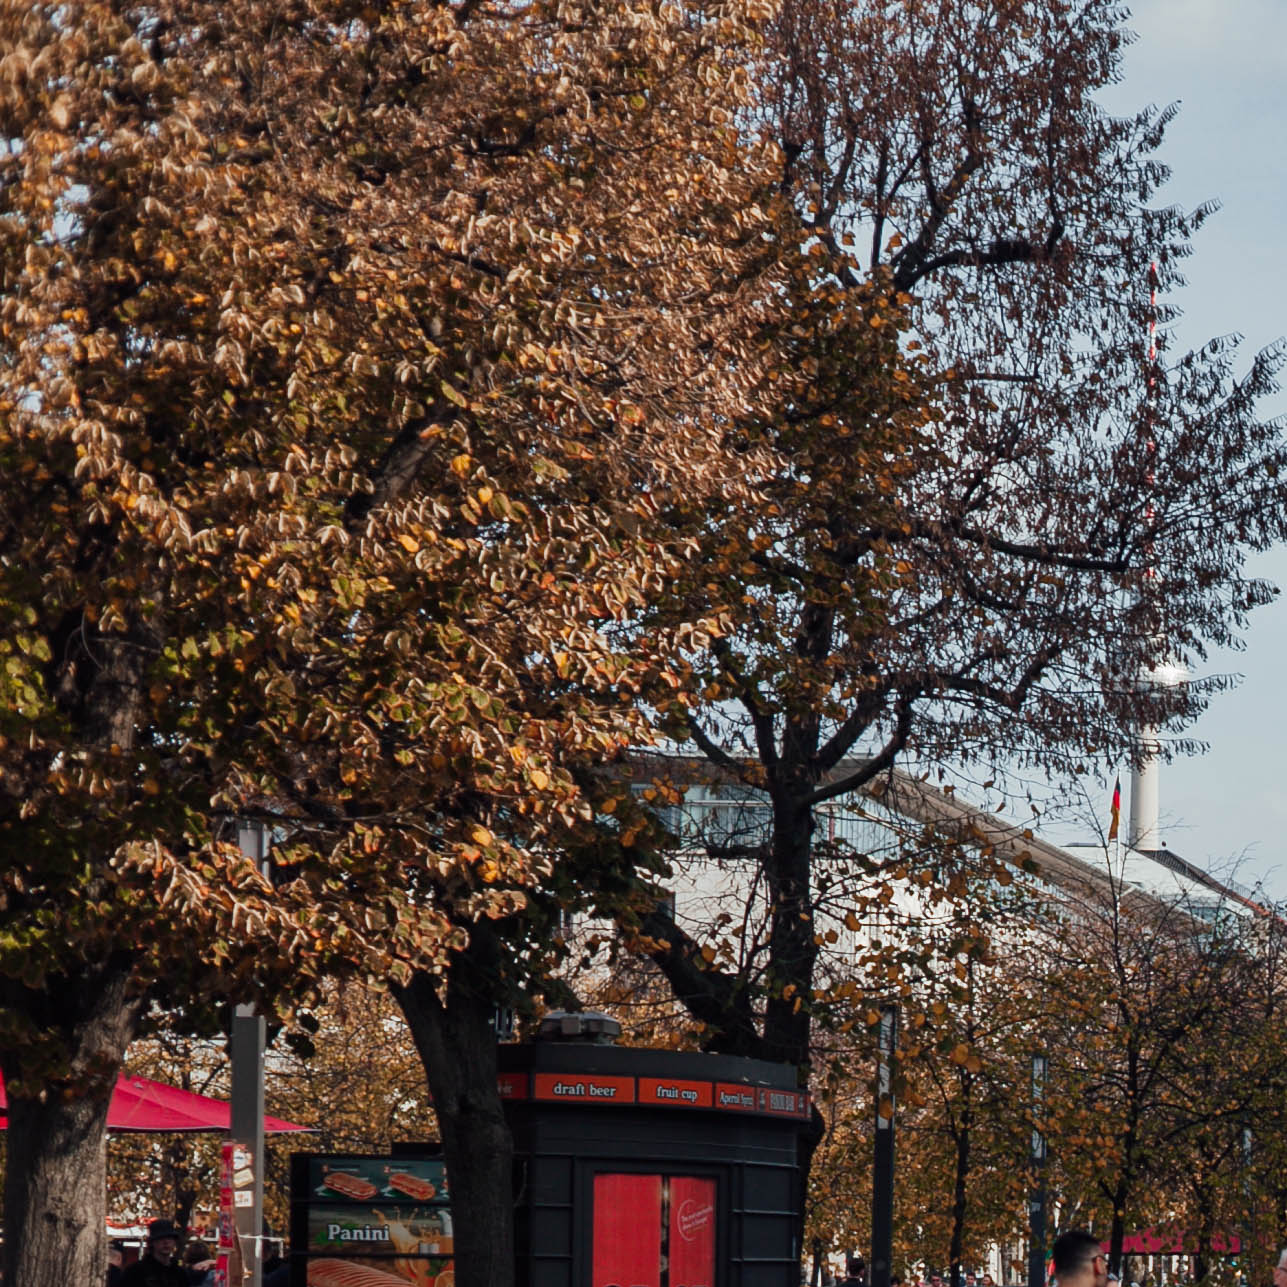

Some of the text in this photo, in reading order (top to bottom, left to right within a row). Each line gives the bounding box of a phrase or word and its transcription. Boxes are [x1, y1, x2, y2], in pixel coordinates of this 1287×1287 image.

[553, 1082, 617, 1097] draft beer
[656, 1085, 698, 1102] fruit cup
[328, 1224, 390, 1241] Panini
